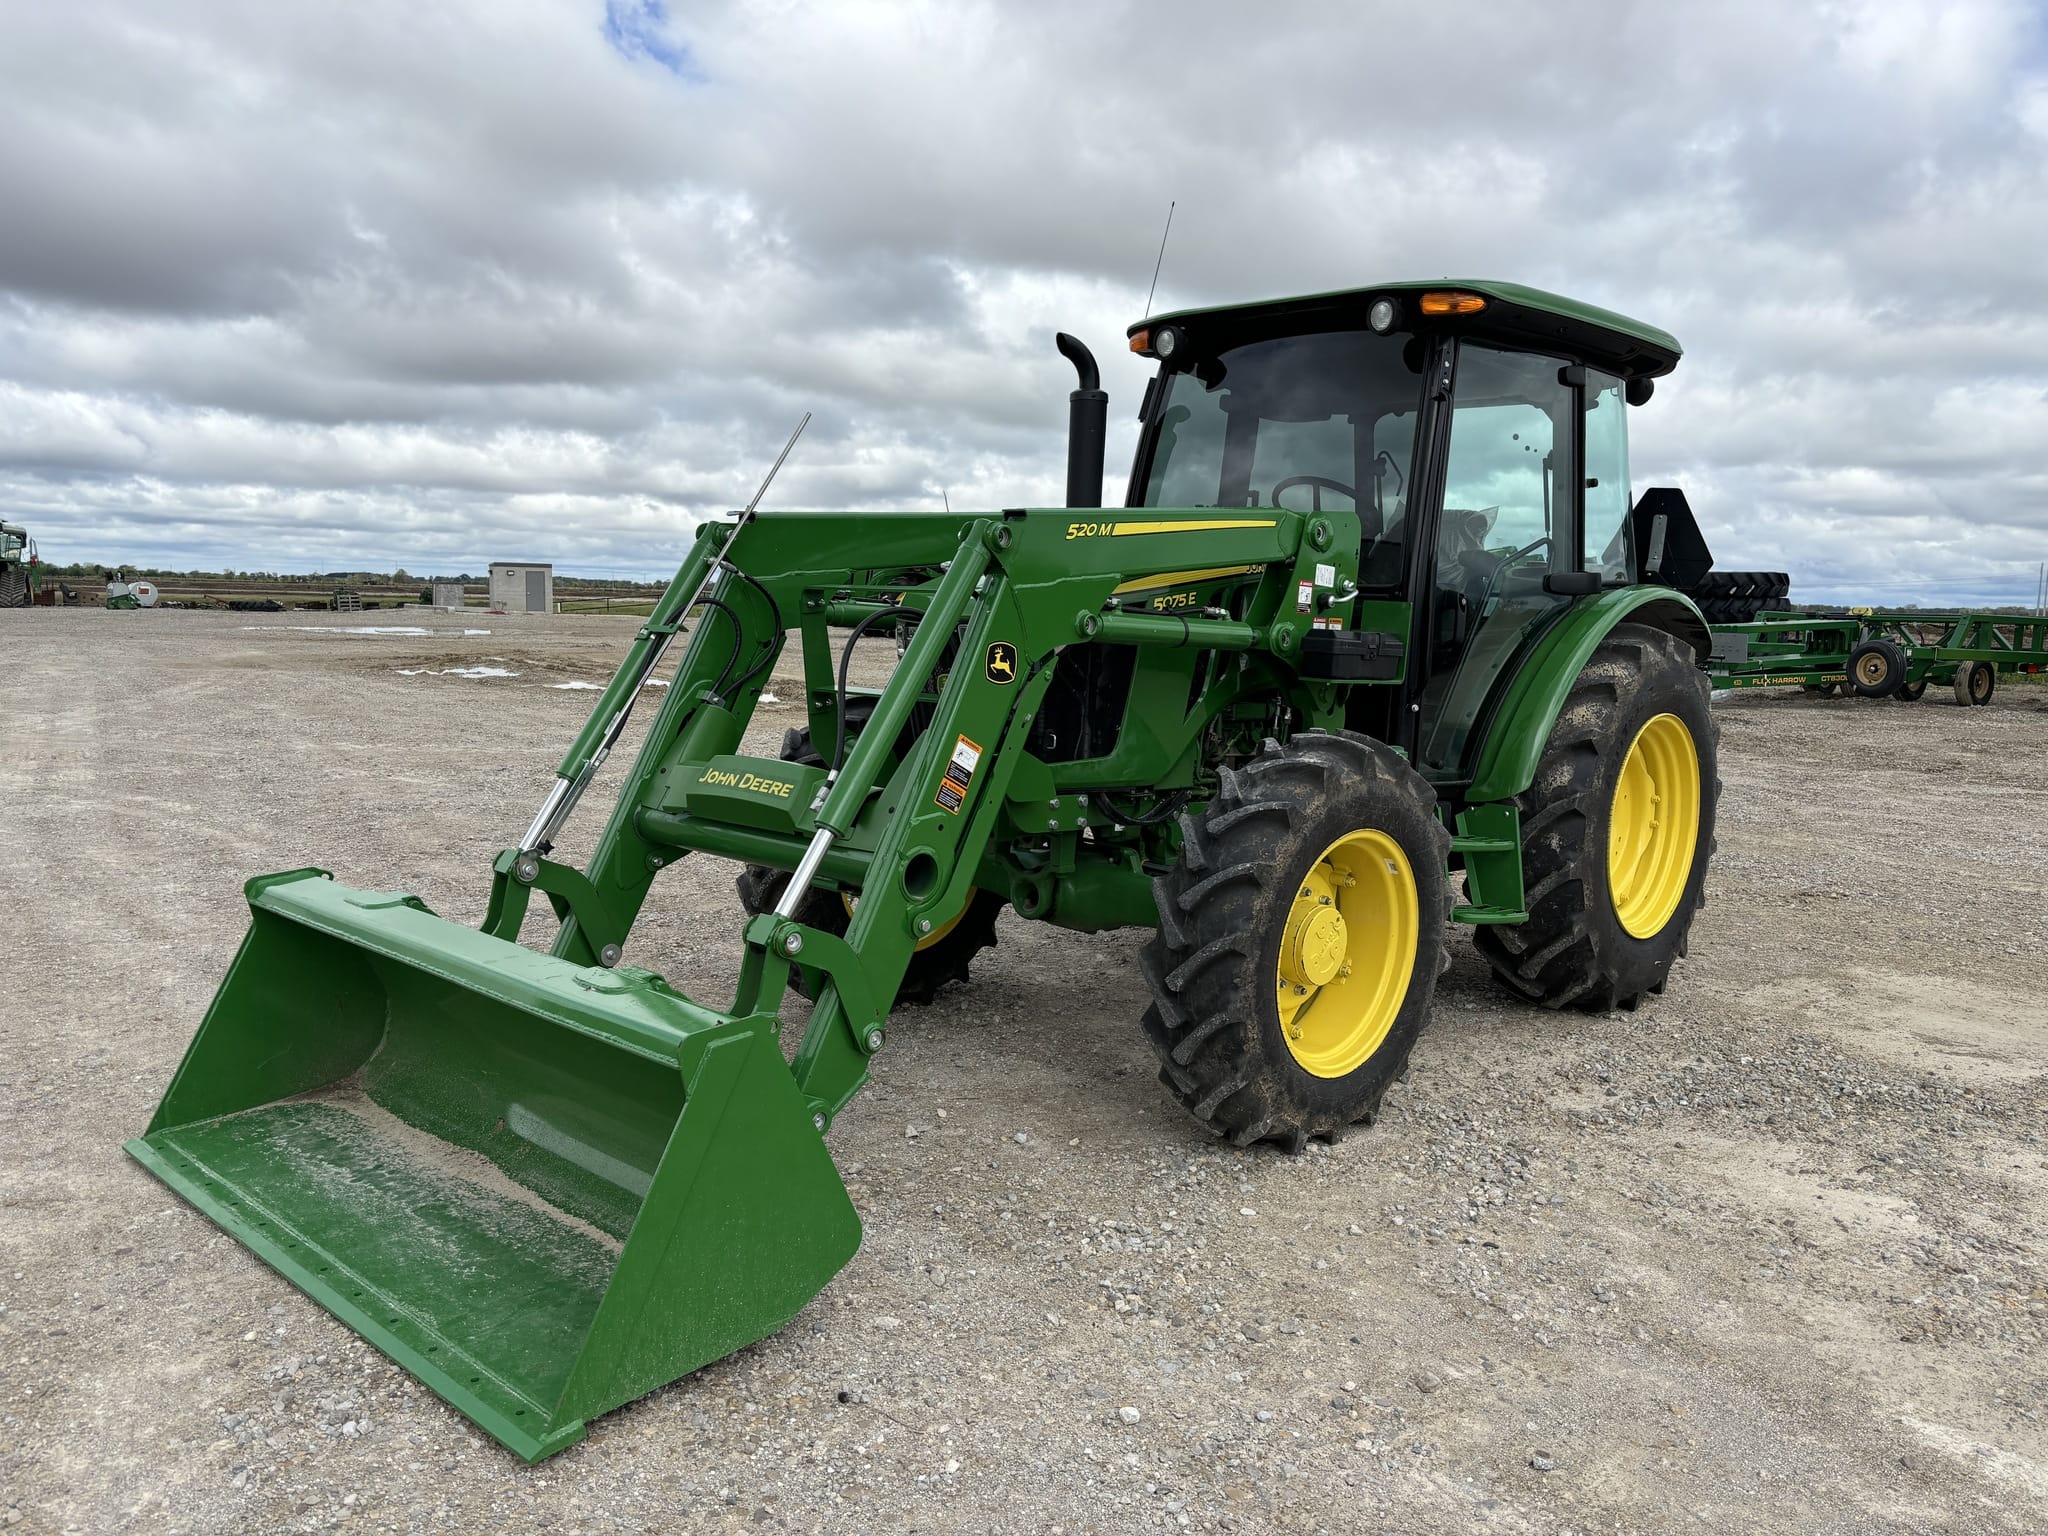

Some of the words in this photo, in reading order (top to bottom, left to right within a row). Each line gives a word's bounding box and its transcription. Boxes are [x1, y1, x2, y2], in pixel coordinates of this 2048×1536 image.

[1065, 523, 1098, 540] 520
[1098, 523, 1112, 536] M
[1153, 593, 1187, 611] 5075
[1188, 591, 1197, 605] E
[1772, 676, 1807, 684] HARROW
[698, 768, 740, 786] JOHN
[738, 773, 795, 798] DEERE
